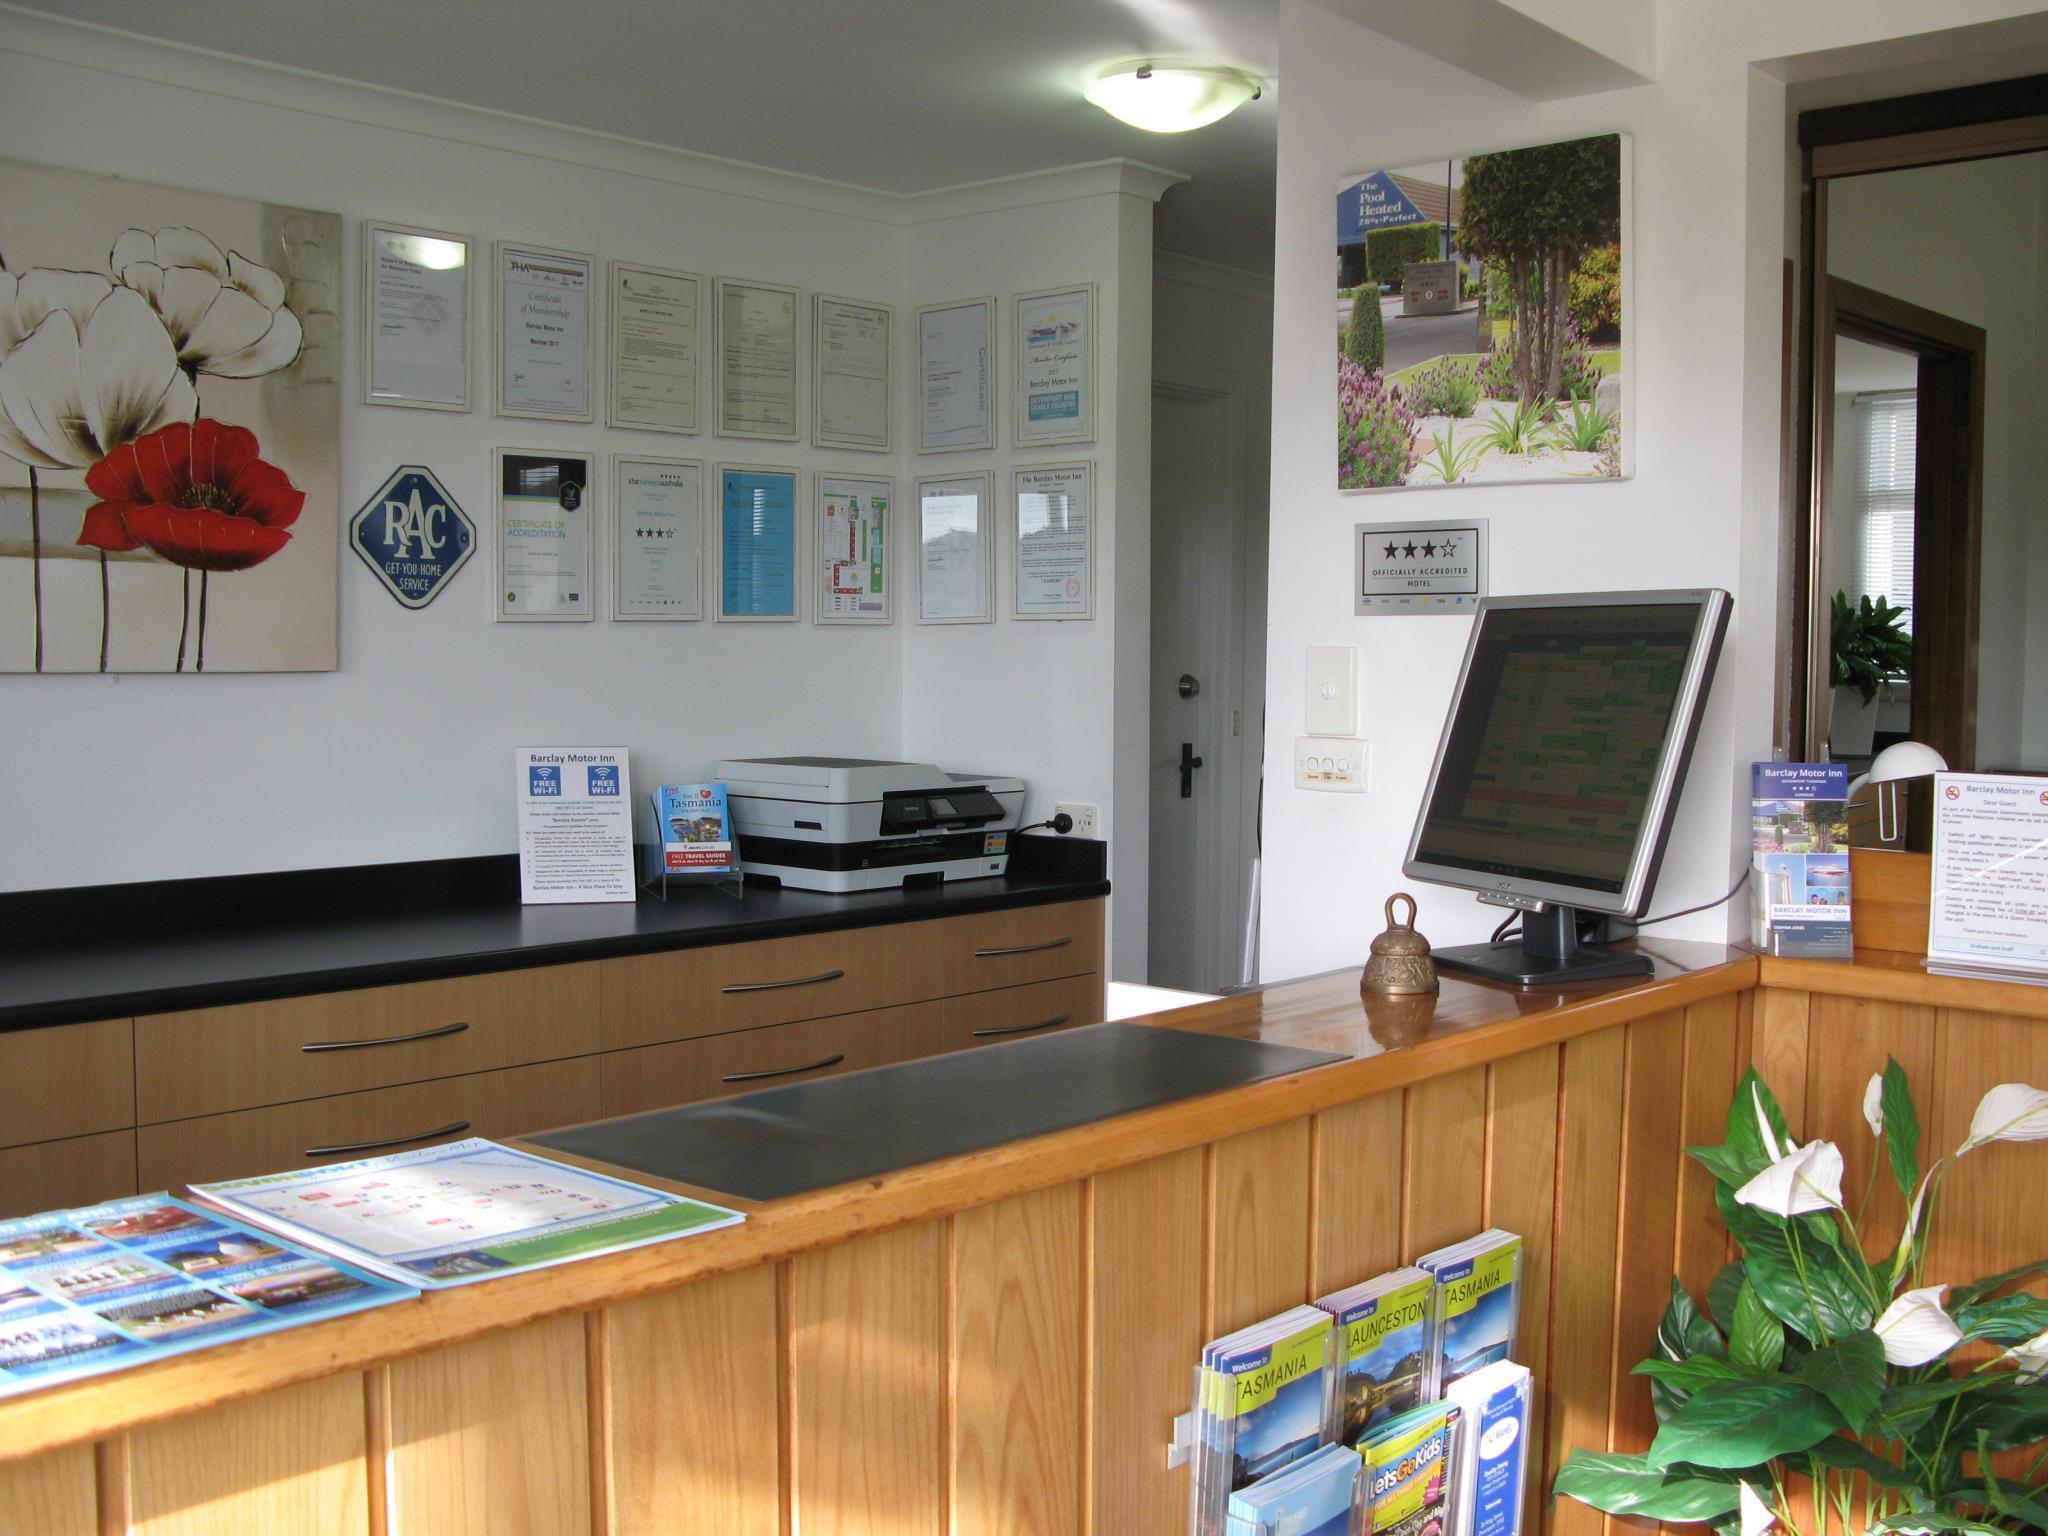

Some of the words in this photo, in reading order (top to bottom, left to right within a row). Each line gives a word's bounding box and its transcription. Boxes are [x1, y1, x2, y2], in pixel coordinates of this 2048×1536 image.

[1360, 191, 1385, 204] Pool
[1360, 202, 1401, 216] Heated
[1029, 380, 1050, 388] Barclay
[1051, 378, 1068, 386] Motor
[384, 488, 446, 560] RAC
[507, 520, 552, 528] CERTIFICATE
[508, 529, 566, 539] ACCREDITATION
[400, 578, 430, 590] SERVICE
[530, 754, 565, 764] Barclay
[568, 754, 598, 762] Motor
[600, 754, 615, 762] Inn
[1765, 769, 1798, 778] Barclay
[1967, 786, 1994, 794] Barclay
[1996, 786, 2020, 795] Motor
[670, 799, 721, 808] Tasmania
[1443, 1270, 1465, 1282] Welcome
[1346, 1309, 1368, 1321] Welcome
[1348, 1302, 1425, 1348] AUNCESTON
[1232, 1359, 1262, 1373] Welcome
[1234, 1354, 1307, 1399] TASMANIA
